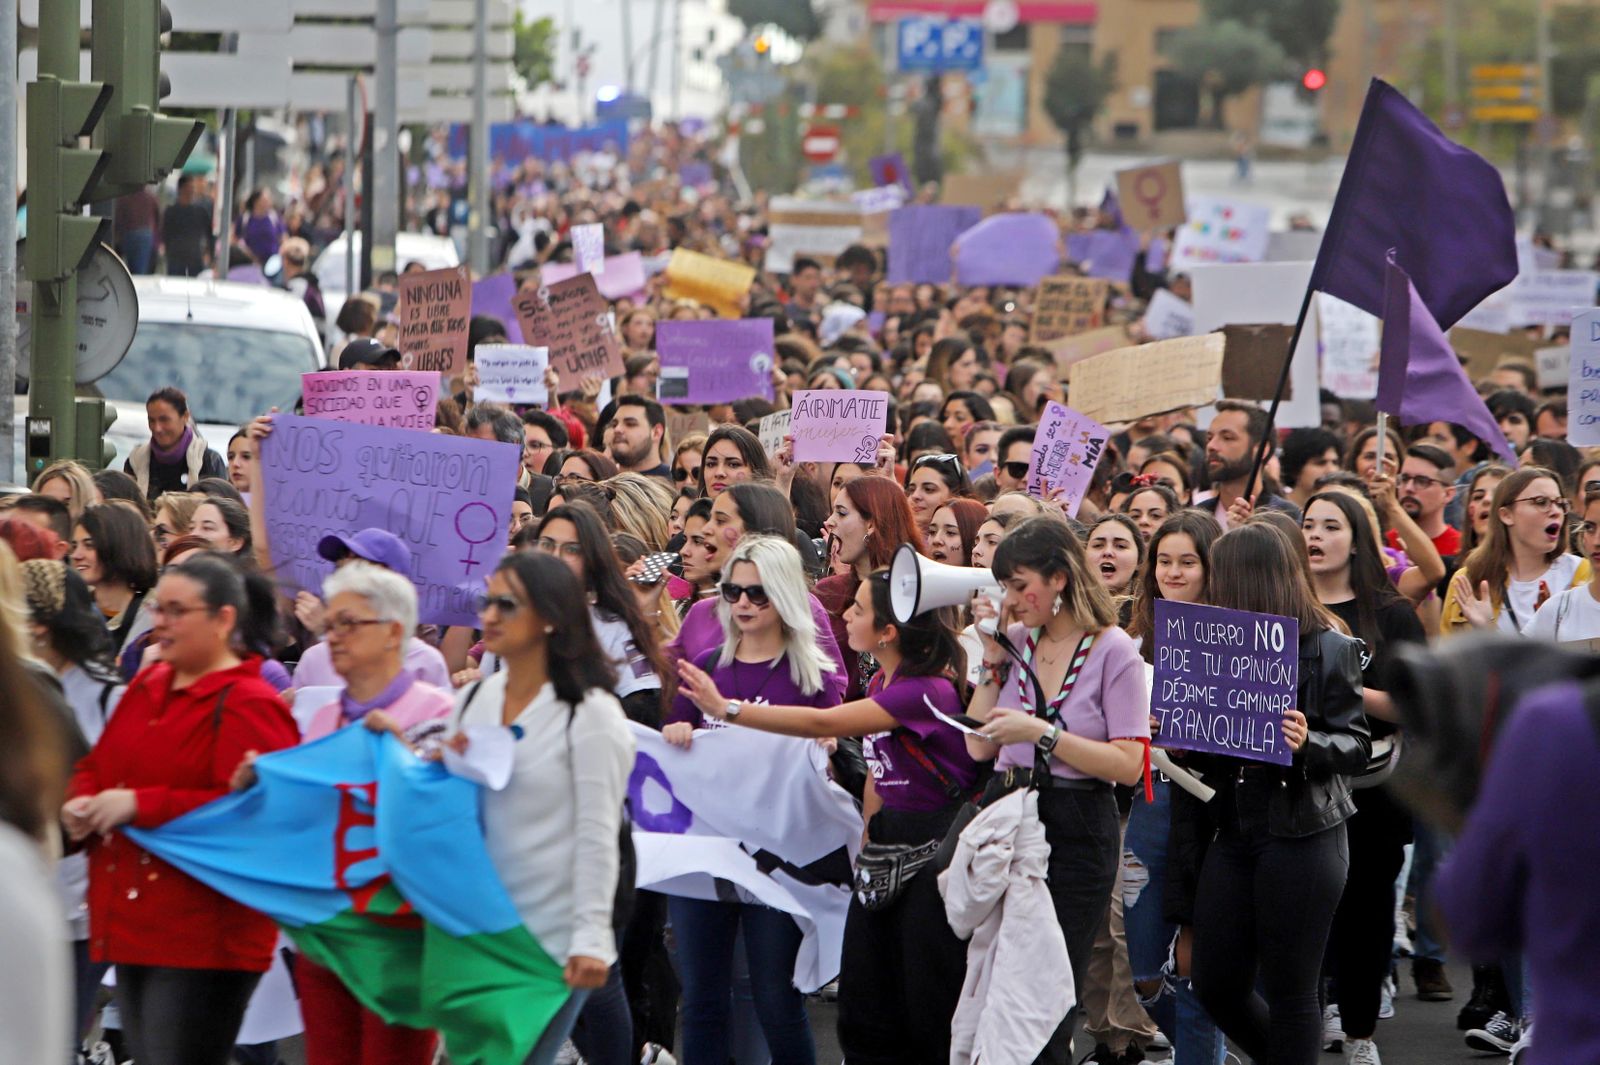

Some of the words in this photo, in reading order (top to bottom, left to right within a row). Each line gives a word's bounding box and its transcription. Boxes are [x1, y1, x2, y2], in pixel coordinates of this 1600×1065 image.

[407, 280, 462, 305] NINGUNA
[417, 347, 454, 371] LIBRES
[307, 376, 359, 392] VIVIMOS
[367, 378, 382, 391] EN
[388, 379, 413, 392] UNA
[306, 396, 366, 415] SOCIEDAD
[373, 395, 403, 409] QUE
[390, 414, 433, 429] MUJER
[269, 423, 344, 475] NOS
[356, 443, 491, 496] quitaron
[1033, 444, 1049, 477] puedo
[1046, 420, 1062, 440] ser
[387, 487, 452, 547] QUE
[1194, 621, 1245, 646] CUERPO
[1254, 620, 1285, 652] NO
[1160, 645, 1191, 673] PIDE
[1201, 652, 1223, 676] TU
[1162, 676, 1218, 707] DÉJAME
[1228, 688, 1292, 715] CAMINAR
